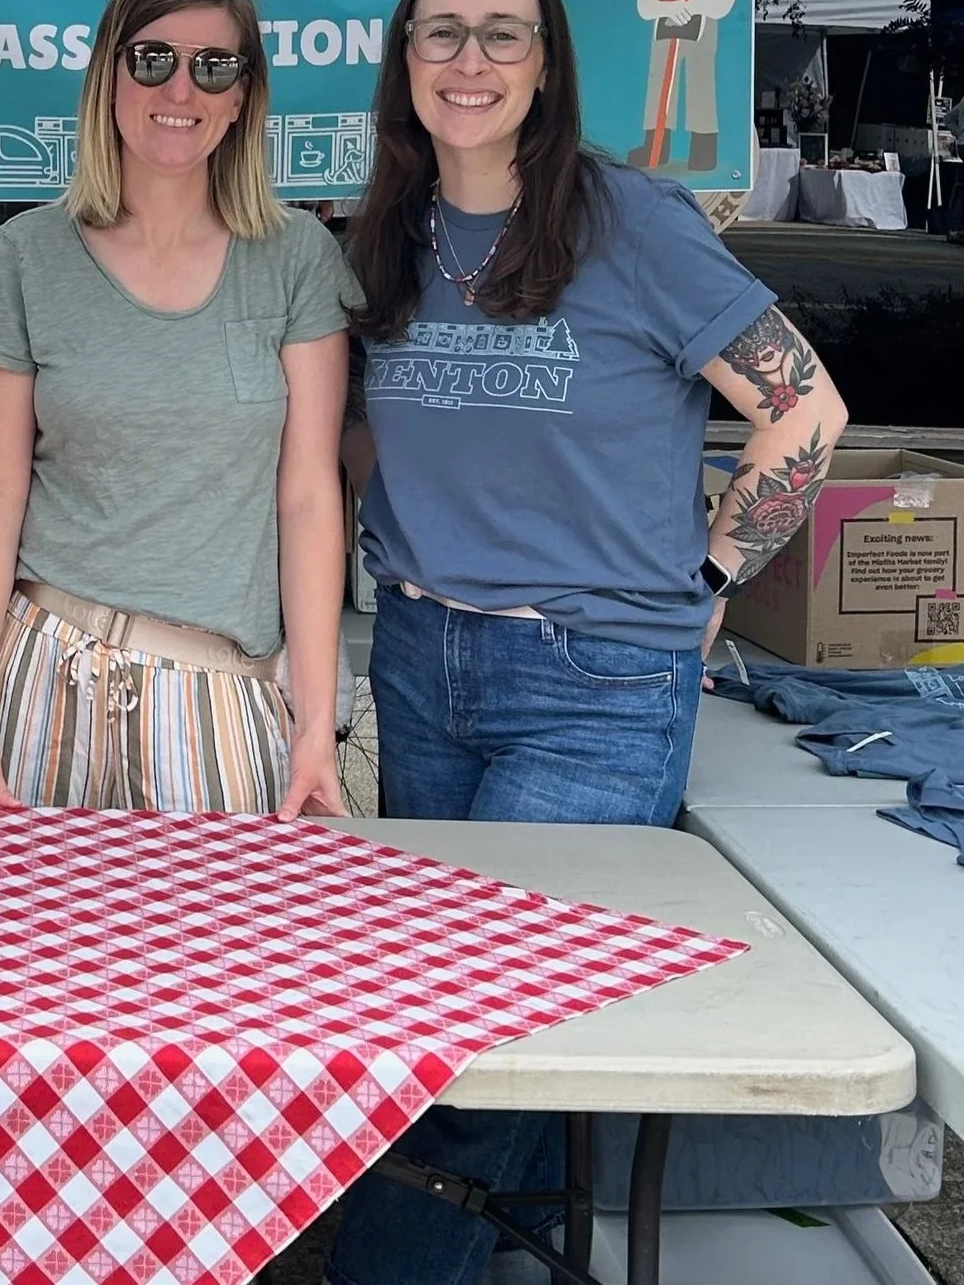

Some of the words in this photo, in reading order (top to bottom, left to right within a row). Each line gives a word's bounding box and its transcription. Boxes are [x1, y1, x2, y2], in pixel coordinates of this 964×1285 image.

[864, 534, 902, 544] Exciting
[905, 534, 933, 542] news:
[934, 550, 949, 558] part
